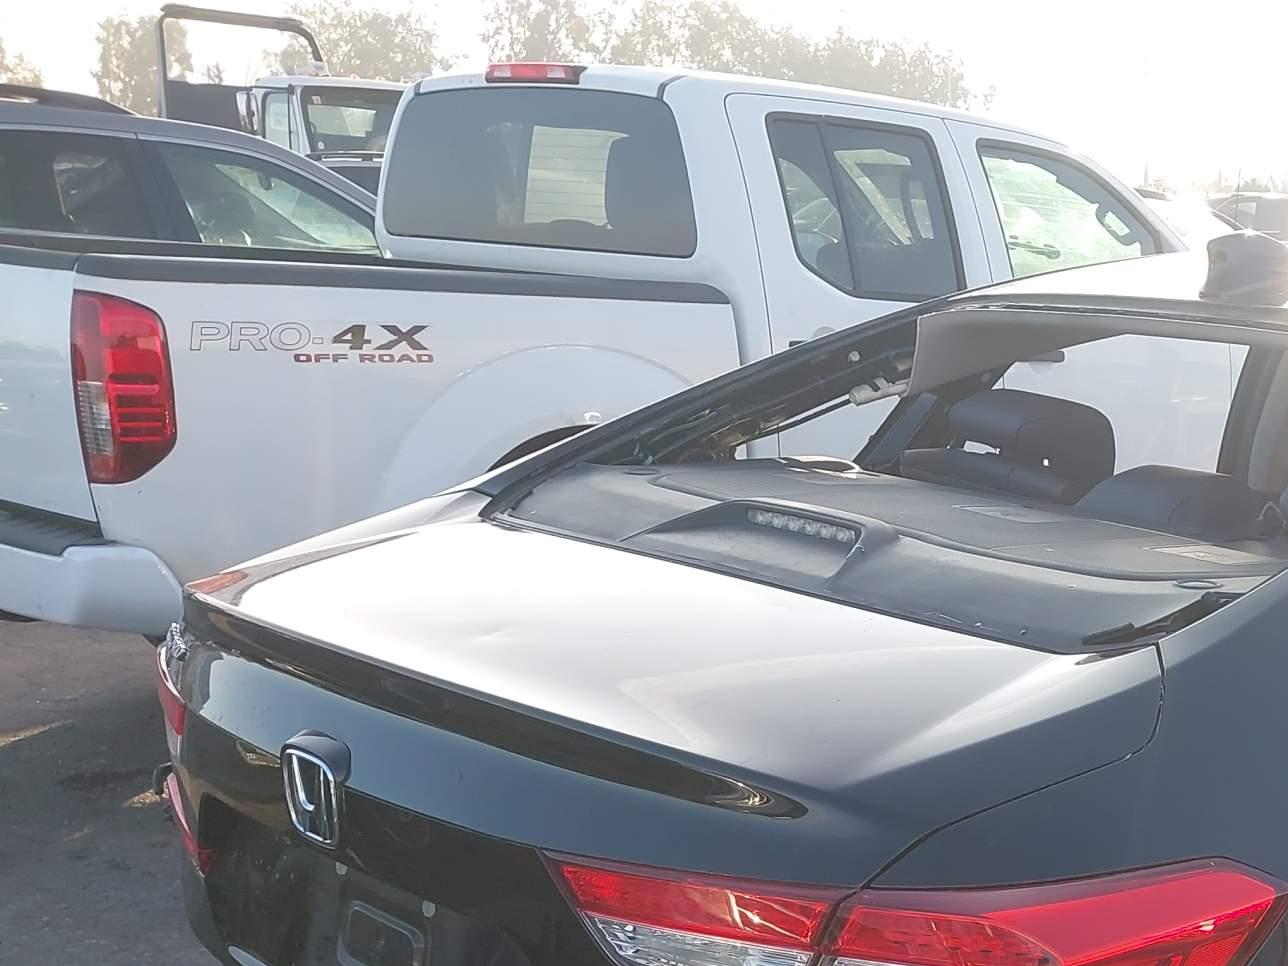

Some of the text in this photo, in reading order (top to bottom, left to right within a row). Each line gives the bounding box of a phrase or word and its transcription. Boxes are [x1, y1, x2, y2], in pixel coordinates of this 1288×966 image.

[190, 321, 431, 351] PRO-4X
[293, 353, 434, 363] OFF ROAD
